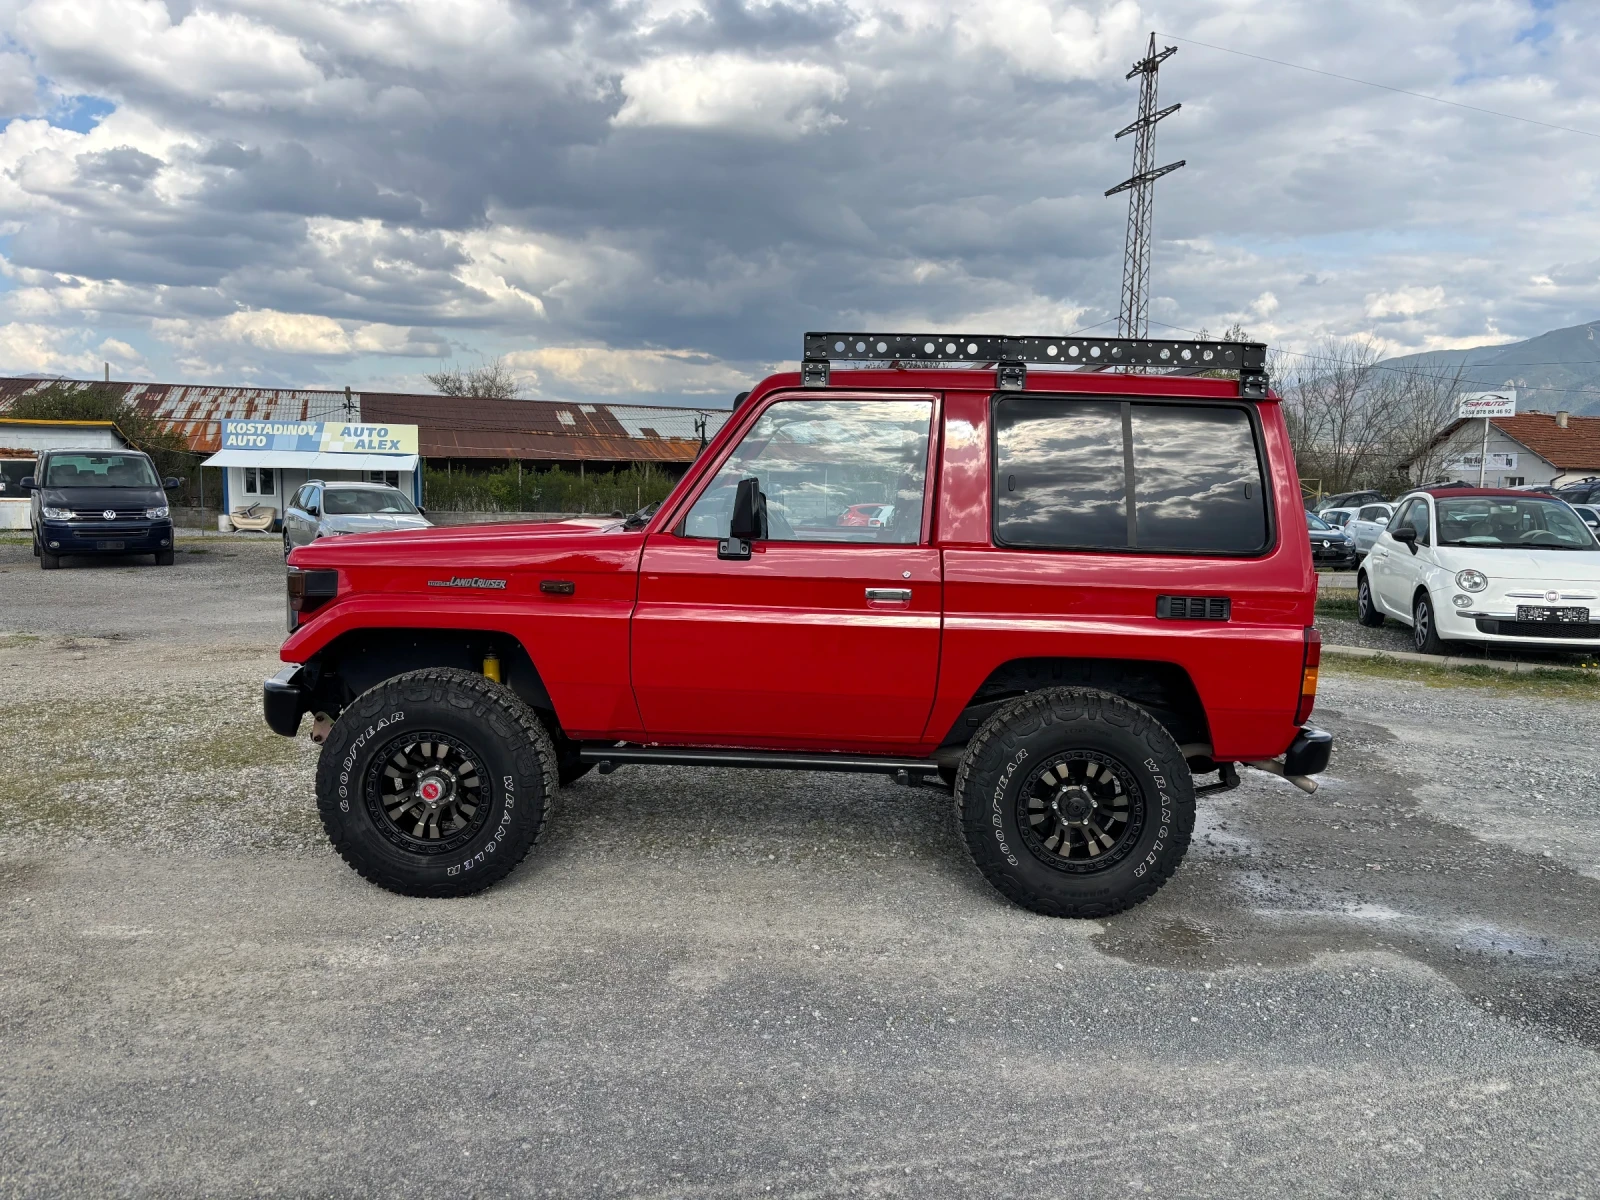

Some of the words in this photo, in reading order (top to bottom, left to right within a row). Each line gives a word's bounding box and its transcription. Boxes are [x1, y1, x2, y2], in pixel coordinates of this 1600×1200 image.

[227, 422, 317, 436] KOSTADINOV
[340, 426, 388, 438] AUTO
[226, 435, 267, 447] AUTO
[353, 439, 401, 450] ALEX
[450, 576, 472, 587] LAND
[472, 578, 506, 588] CRUISER
[338, 711, 405, 813] GOODYEAR
[992, 748, 1029, 866] GOODYEAR
[1133, 758, 1171, 878] WRANGLER
[447, 775, 515, 876] WRANGLER
